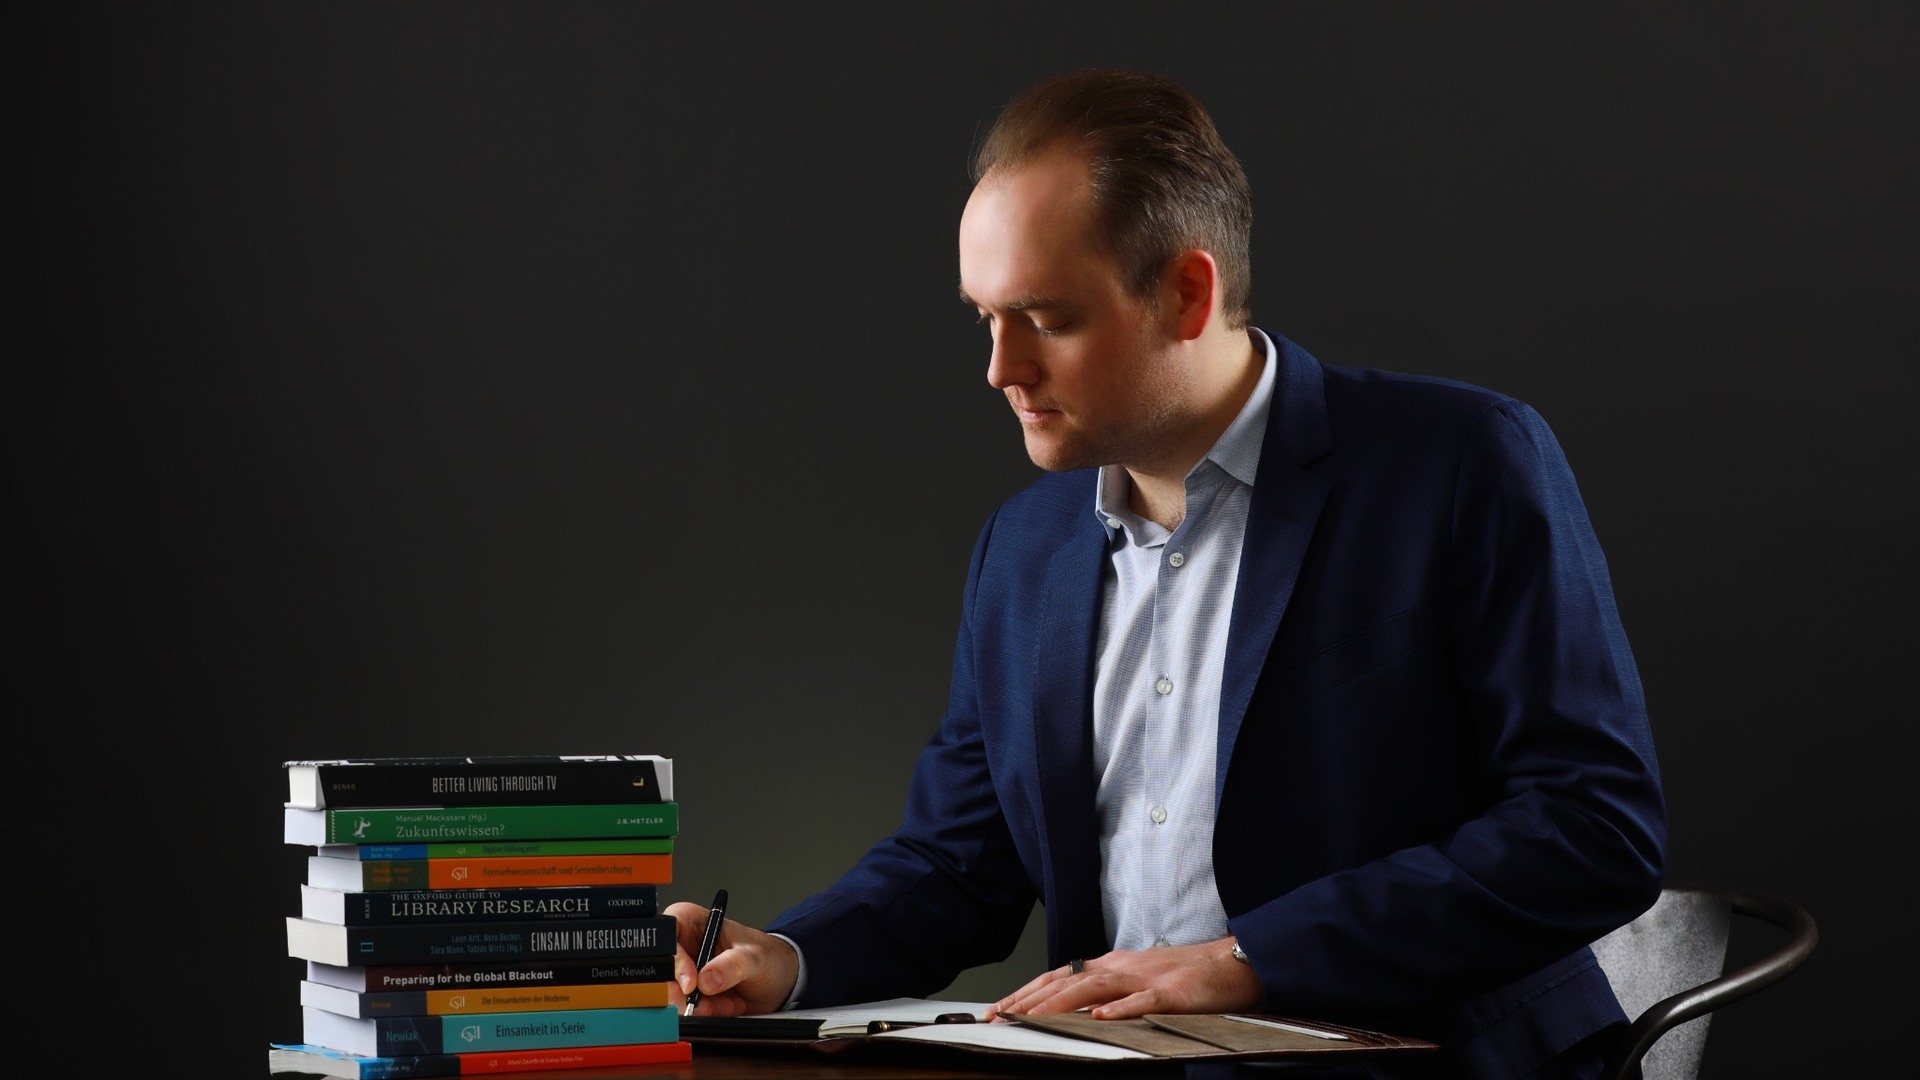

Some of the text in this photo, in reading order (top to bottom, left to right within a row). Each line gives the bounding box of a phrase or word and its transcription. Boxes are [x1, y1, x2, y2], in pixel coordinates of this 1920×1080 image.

[432, 775, 557, 793] BETTER LIVING THROUGH TV
[396, 813, 487, 823] Manuel Mackasare (Hg.)
[396, 824, 505, 838] Zukunftswissen?
[483, 864, 632, 877] Fernsehwissenschaft und Serienforschung
[391, 891, 501, 901] THE OXFORD GUIDE TO
[391, 898, 590, 917] LIBRARY RESEARCH
[607, 899, 643, 907] OXFORD
[483, 934, 498, 942] Nora
[531, 927, 657, 952] EINSAM IN GESELLSCHAFT
[430, 945, 445, 954] Sara
[467, 944, 487, 953] Tobias
[506, 943, 523, 954] (Hg.)
[591, 965, 656, 978] Denis Newiak
[383, 970, 553, 987] Preparing for the Global Blackout
[482, 993, 570, 1005] Die Einsamkeiten der Moderne
[386, 1030, 418, 1042] Newiak
[496, 1022, 585, 1038] Einsamkeit in Serie
